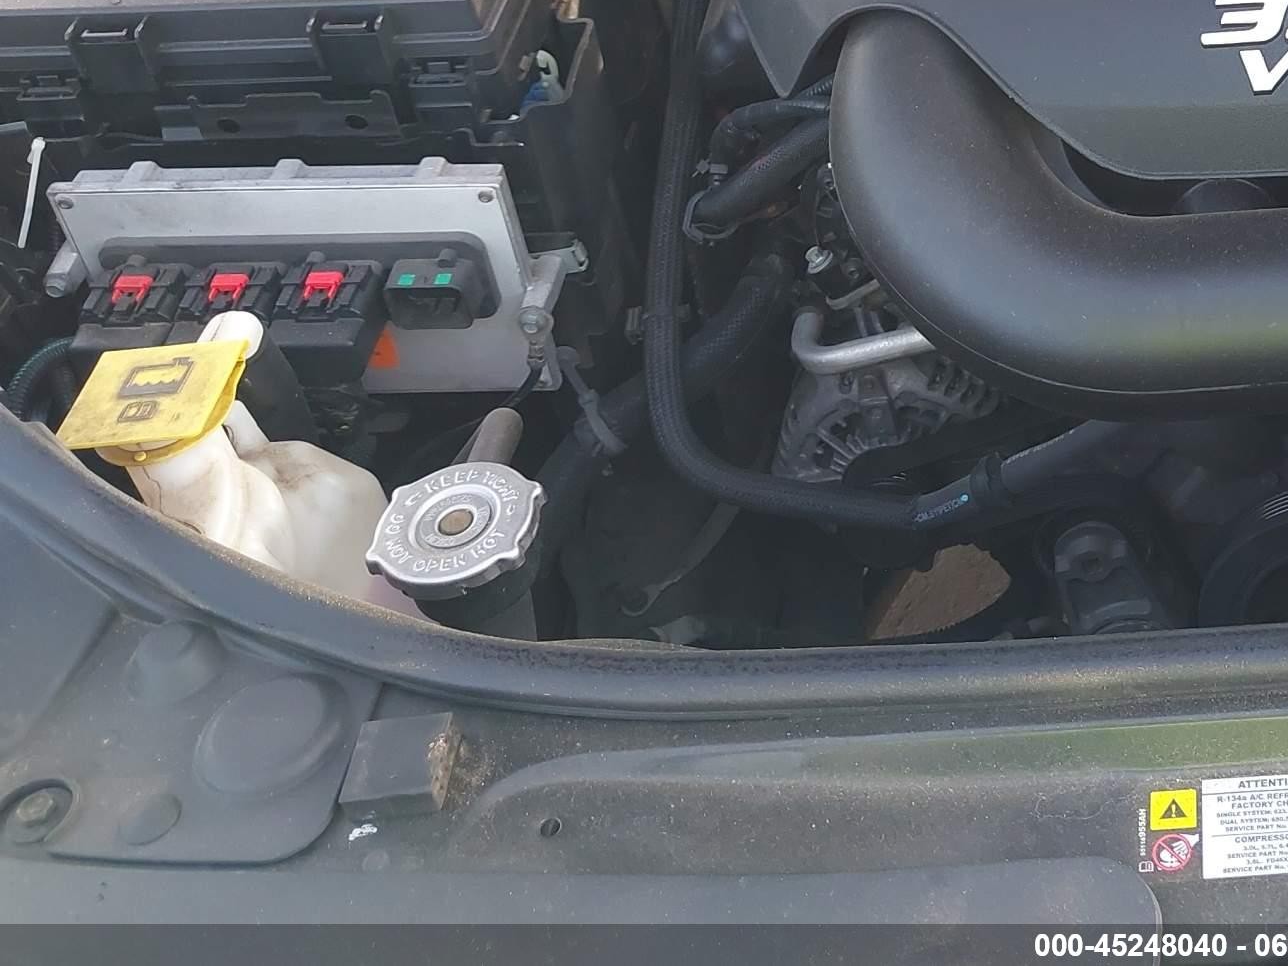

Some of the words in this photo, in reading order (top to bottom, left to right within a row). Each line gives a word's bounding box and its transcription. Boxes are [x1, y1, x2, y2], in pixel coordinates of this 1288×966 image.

[425, 469, 479, 493] KEEP
[383, 538, 415, 565] NOT
[413, 554, 467, 574] OPEN
[471, 527, 505, 559] HOT
[1216, 794, 1246, 803] R-134a
[1231, 800, 1273, 809] FACTORY
[1227, 851, 1256, 859] SERVICE
